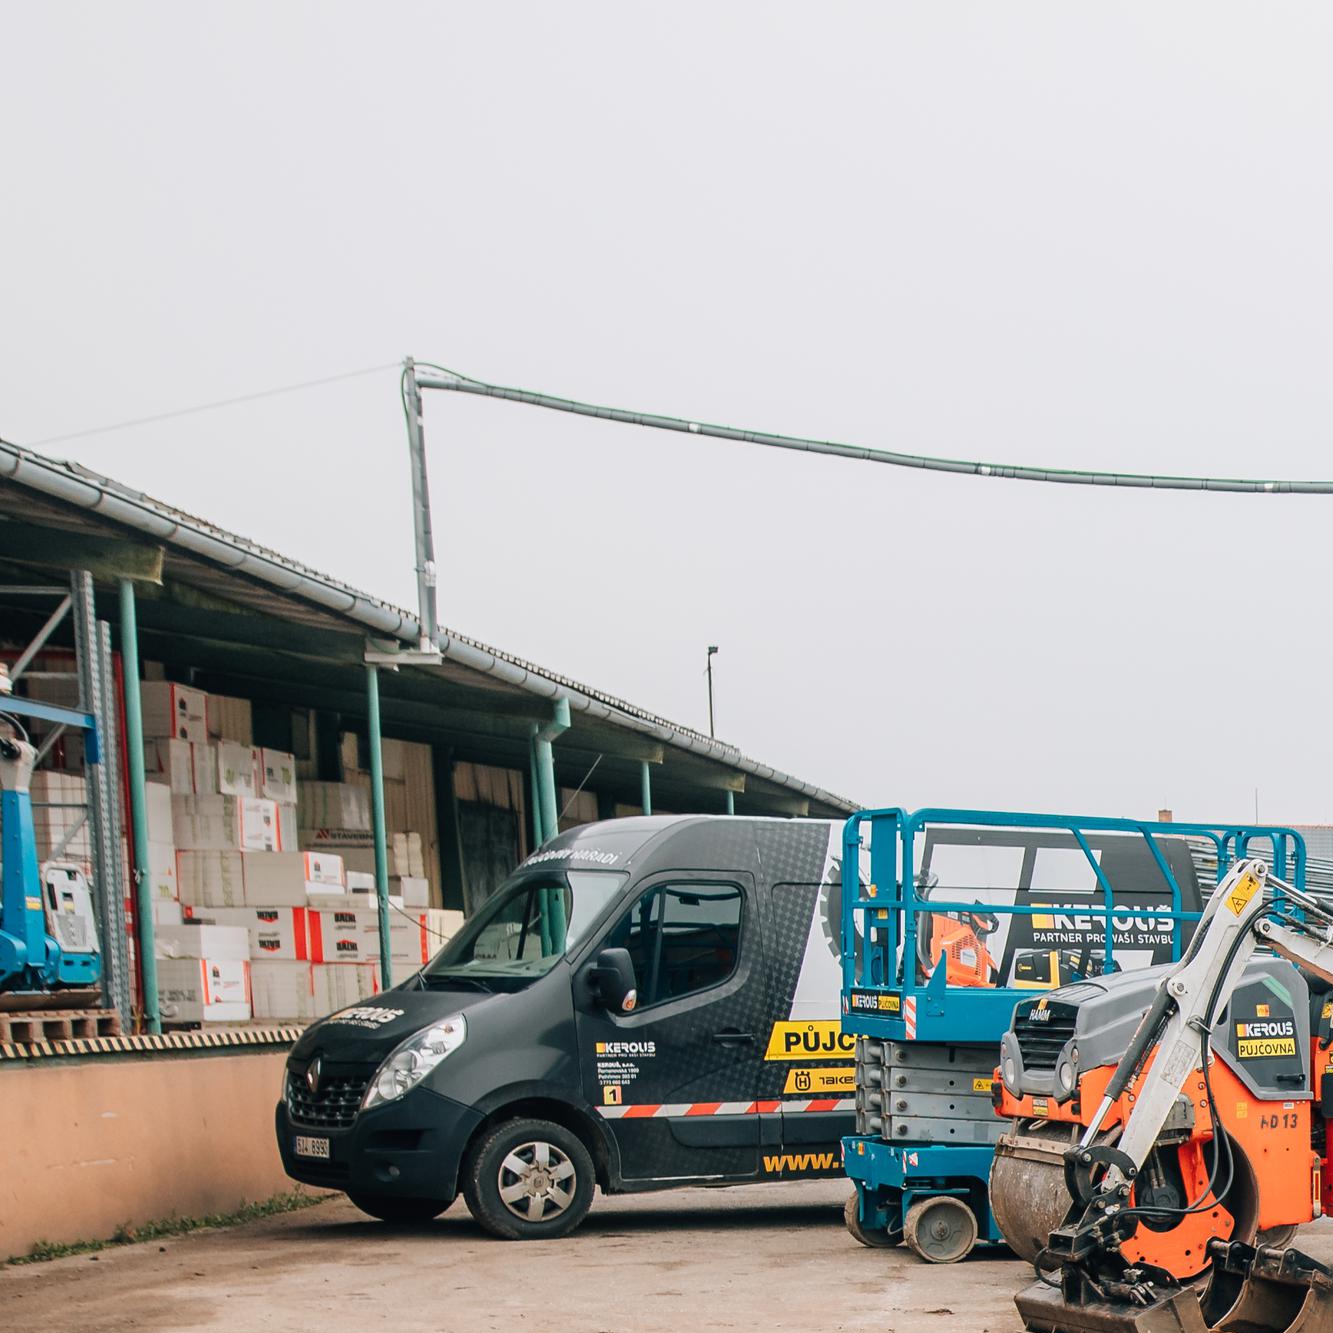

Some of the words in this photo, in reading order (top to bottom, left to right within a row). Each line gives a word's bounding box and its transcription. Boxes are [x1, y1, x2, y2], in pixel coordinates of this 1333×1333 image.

[1033, 932, 1083, 943] PARTNER
[609, 1089, 617, 1102] 1
[1283, 1113, 1298, 1128] 13
[764, 1152, 840, 1173] www.
